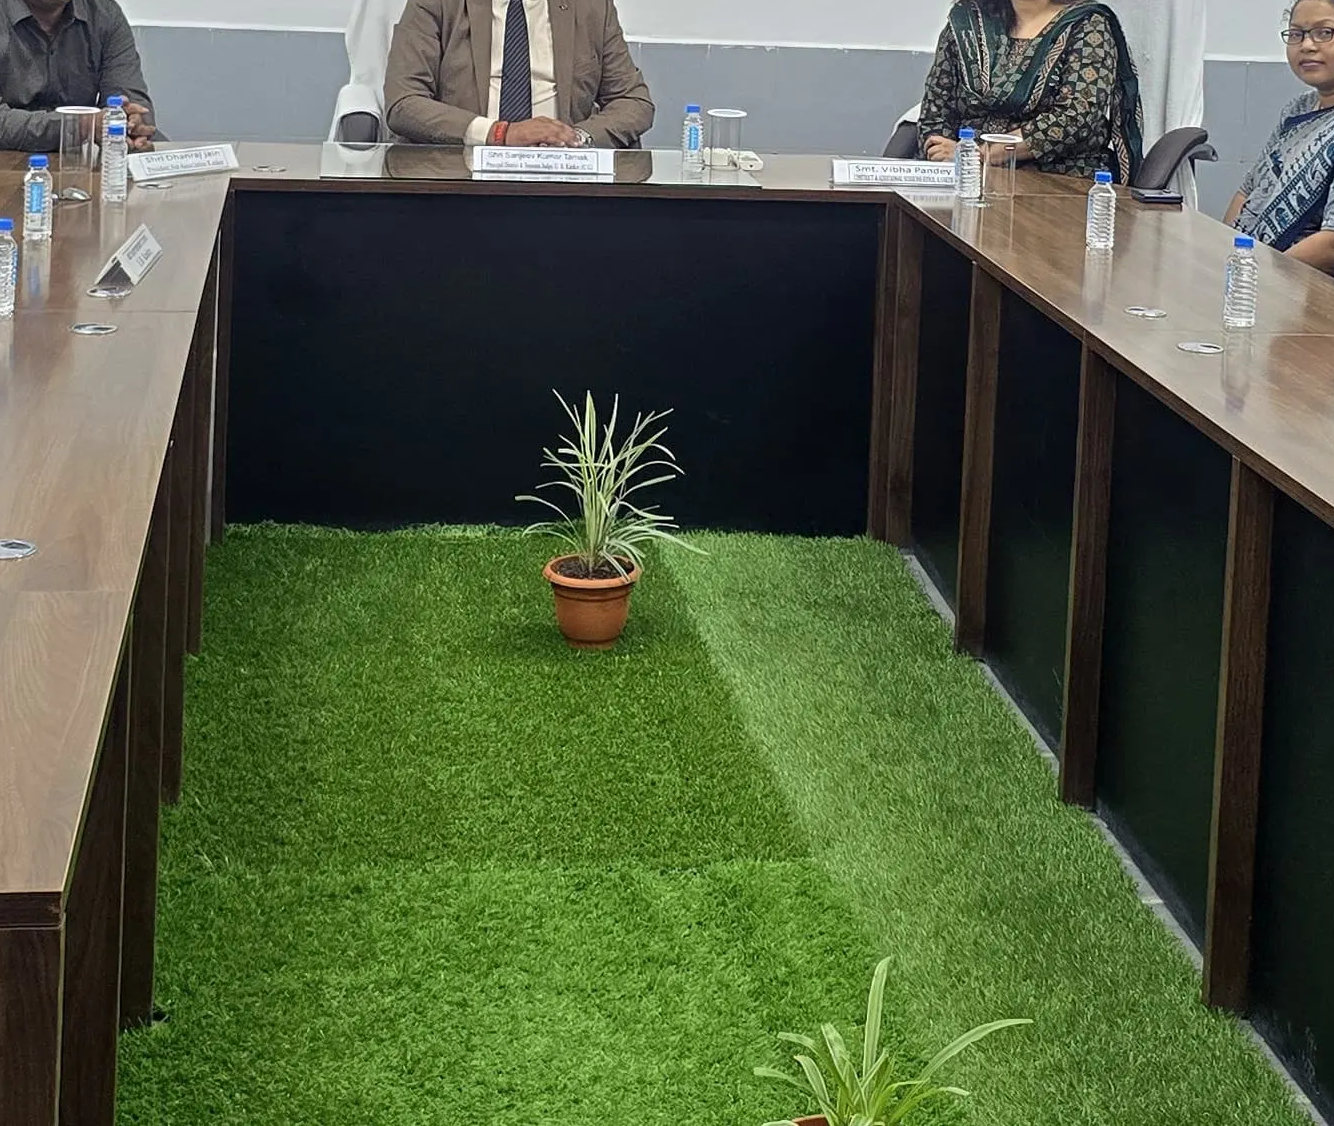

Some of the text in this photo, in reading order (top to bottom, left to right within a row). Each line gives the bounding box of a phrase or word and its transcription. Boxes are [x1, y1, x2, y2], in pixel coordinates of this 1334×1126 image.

[855, 165, 952, 176] Smt. Vibha Pandey
